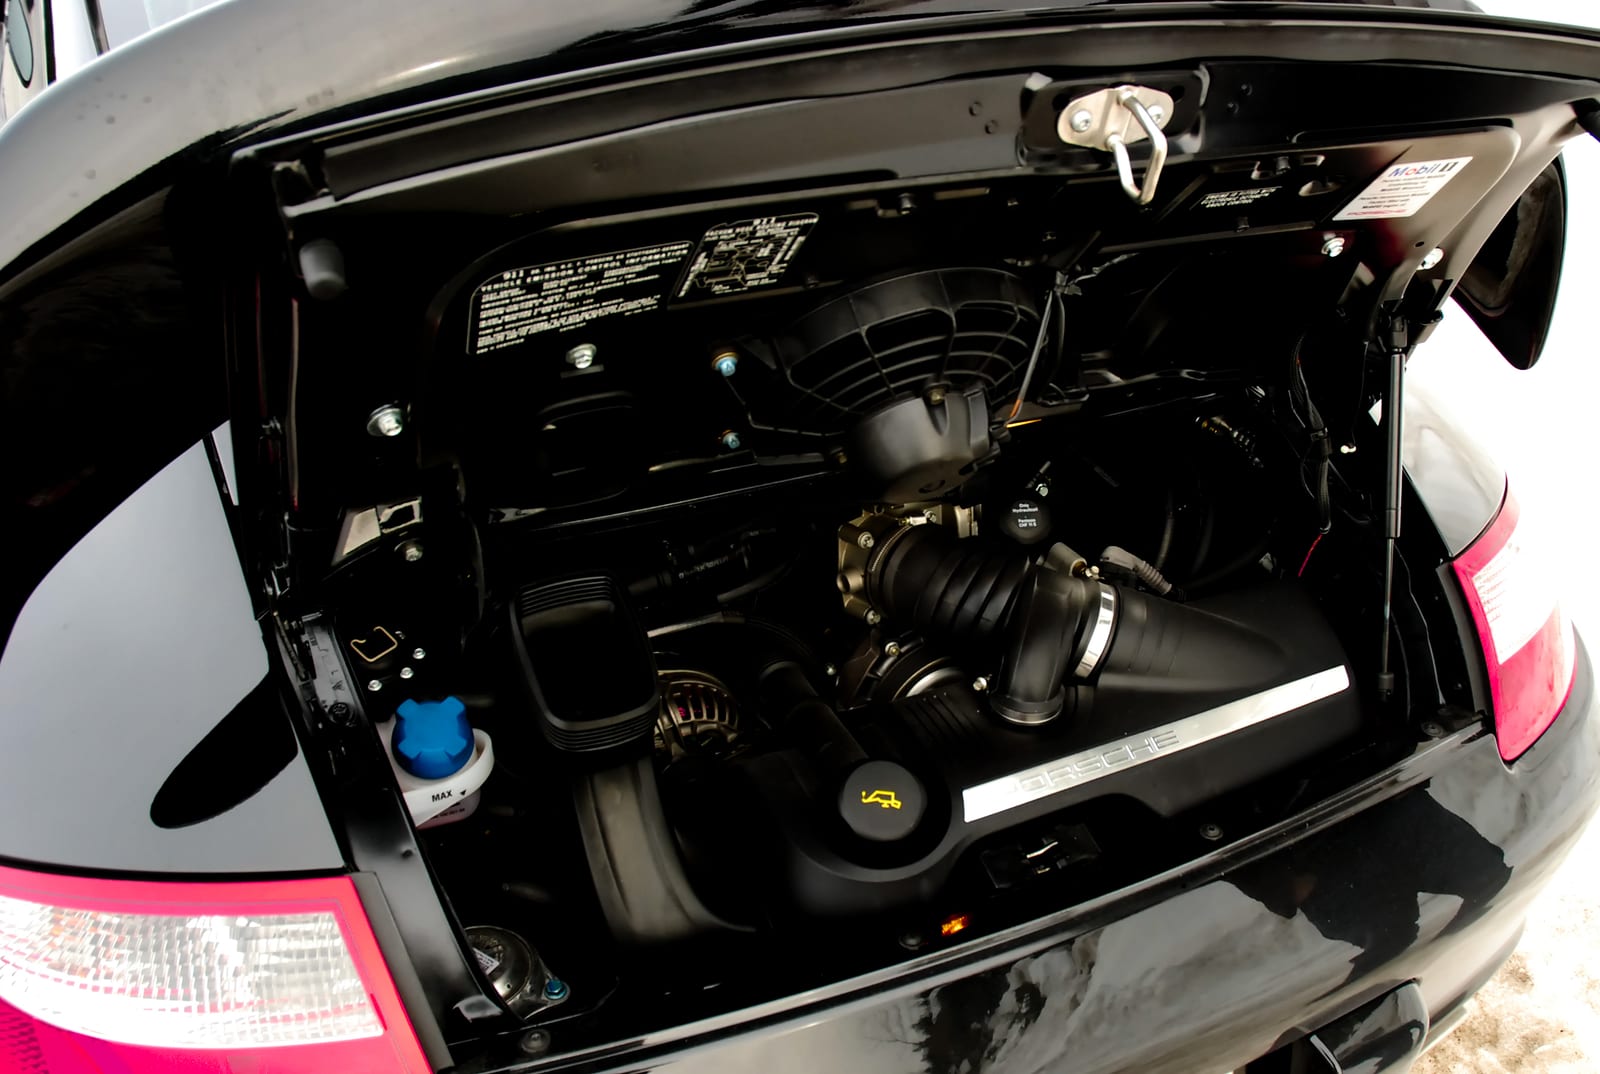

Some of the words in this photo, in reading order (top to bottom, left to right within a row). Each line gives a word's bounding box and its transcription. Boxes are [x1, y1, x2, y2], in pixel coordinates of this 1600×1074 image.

[1388, 163, 1441, 177] Mobil
[481, 278, 522, 293] VEHICLE
[526, 268, 575, 284] EMISSION
[577, 261, 621, 276] CONTROL
[625, 248, 689, 265] INFORMATION
[503, 269, 525, 281] 911
[1006, 729, 1181, 795] ORSCHE
[431, 789, 453, 803] MAX
